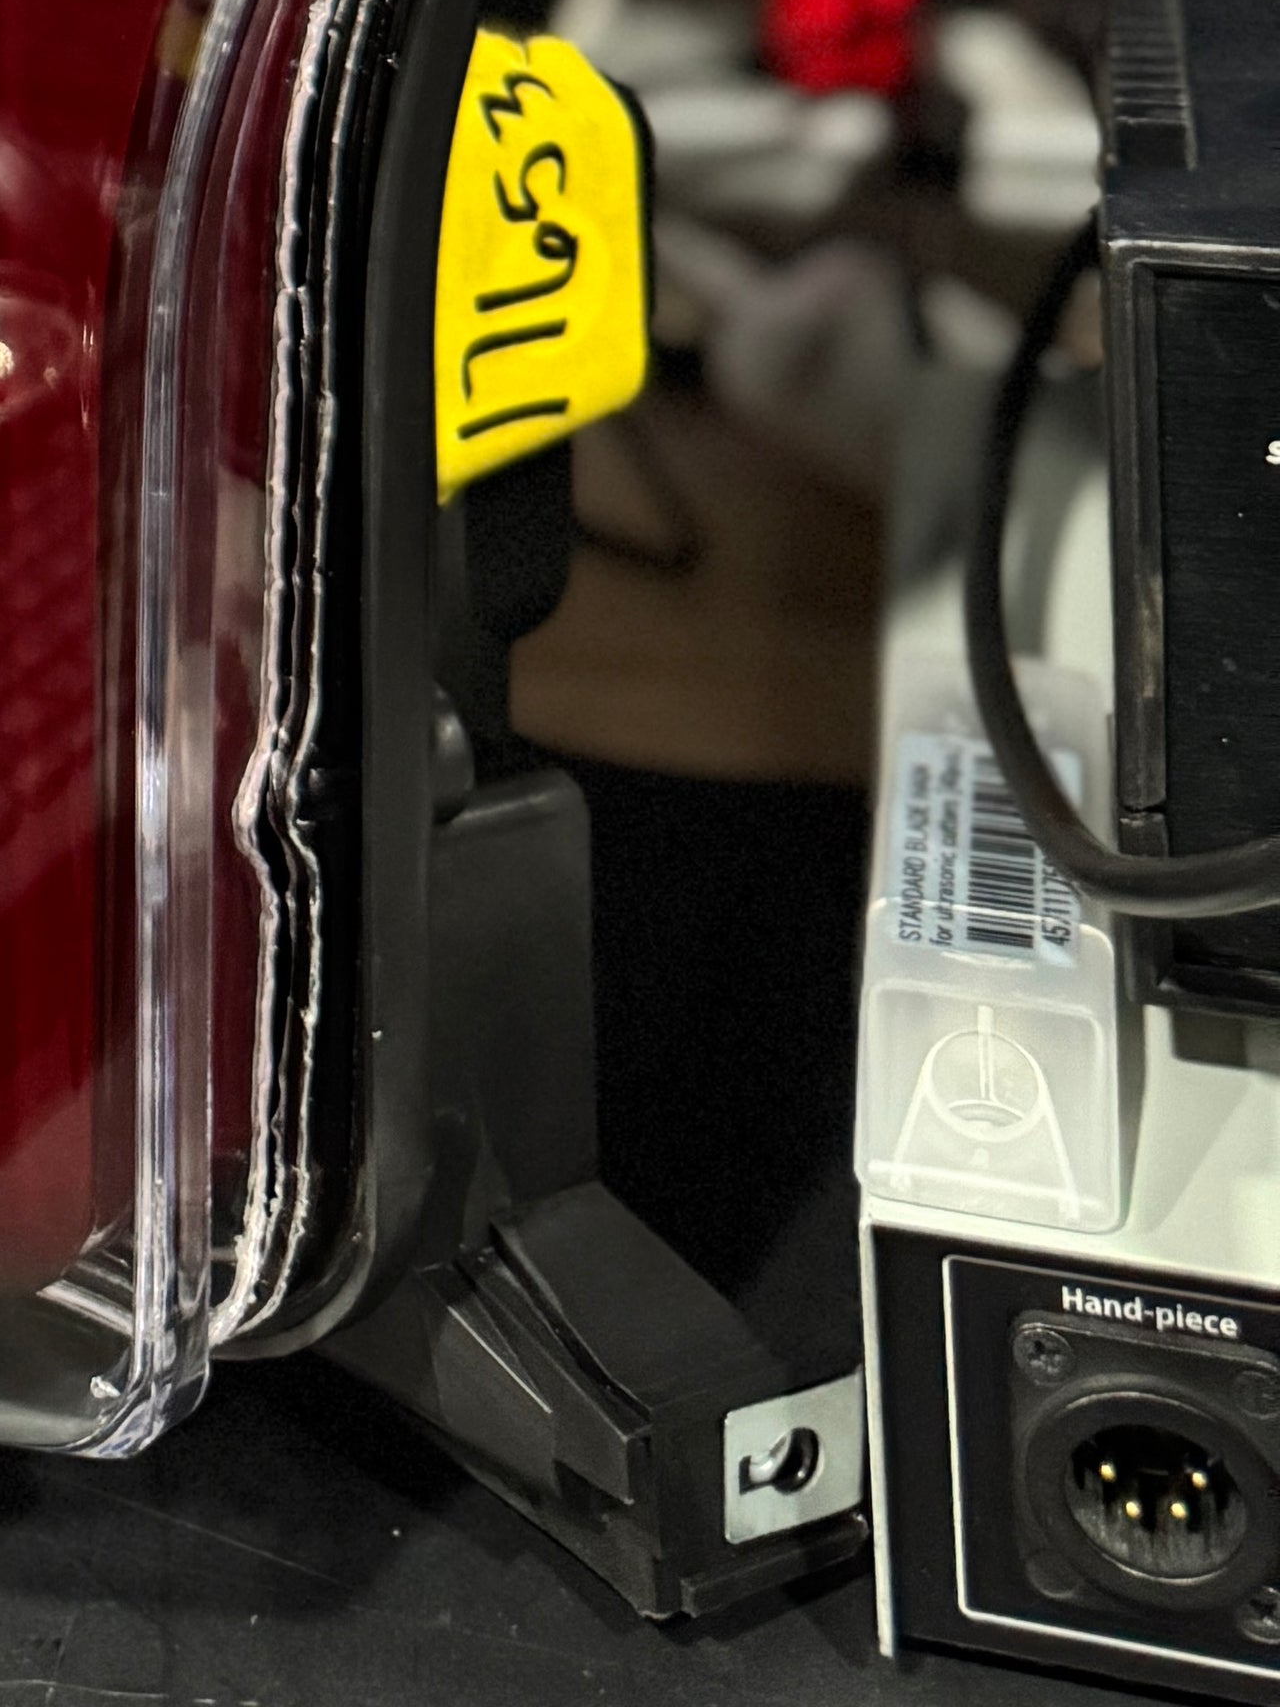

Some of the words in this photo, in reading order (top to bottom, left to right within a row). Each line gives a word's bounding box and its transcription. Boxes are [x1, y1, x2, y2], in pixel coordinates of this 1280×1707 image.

[457, 70, 578, 440] 17653
[898, 856, 927, 942] STANDARD
[929, 924, 953, 947] for
[1061, 1285, 1238, 1338] Hand-piece
